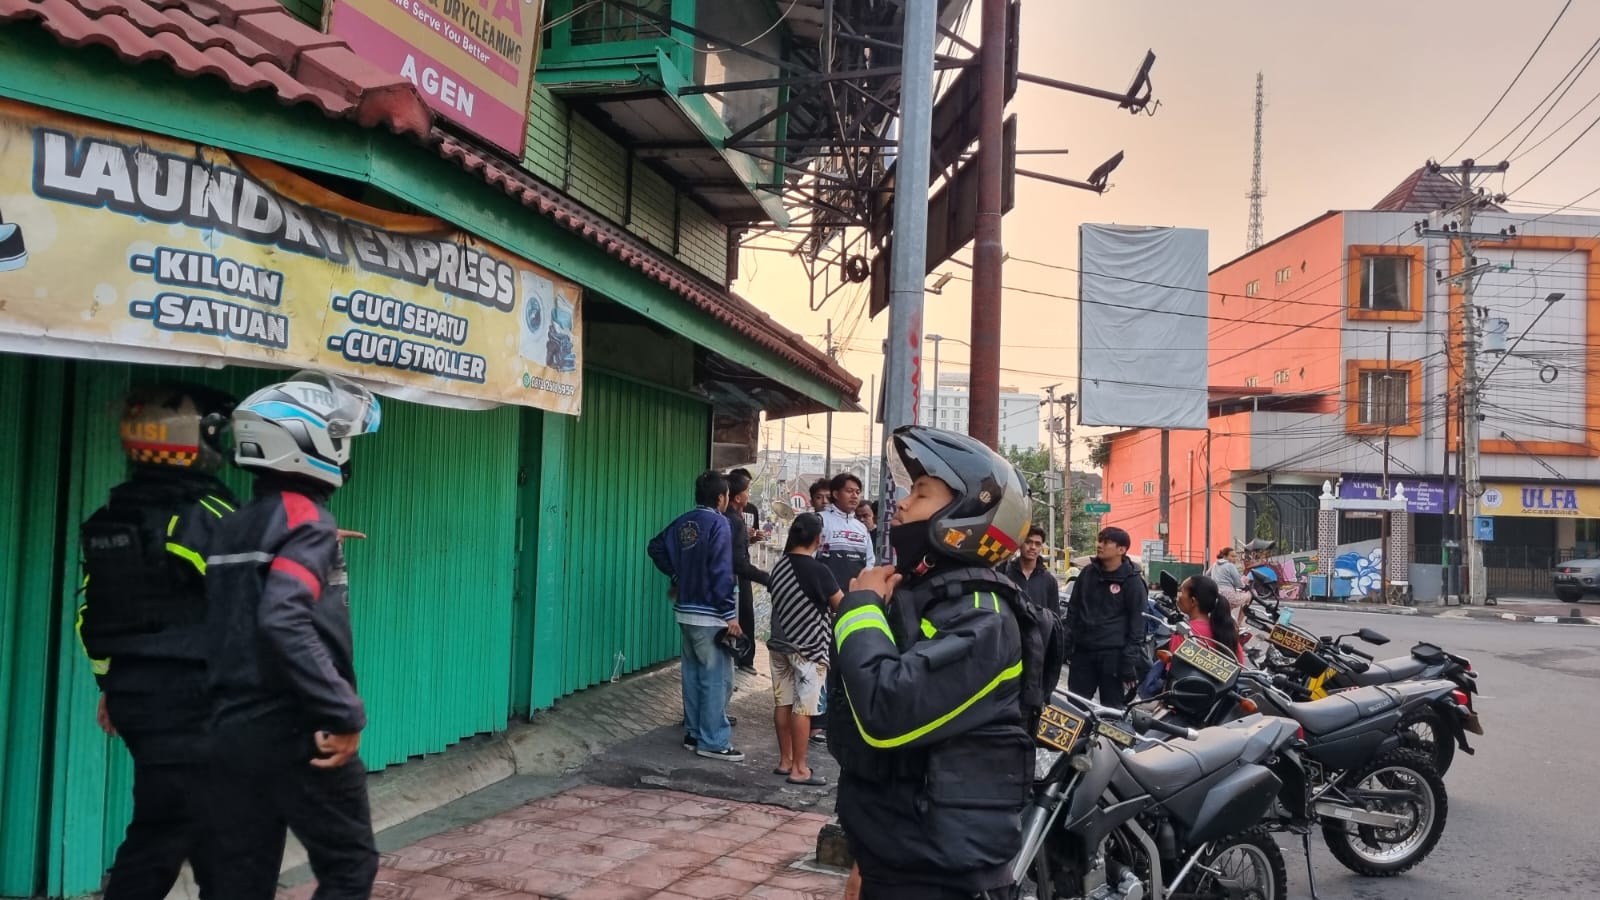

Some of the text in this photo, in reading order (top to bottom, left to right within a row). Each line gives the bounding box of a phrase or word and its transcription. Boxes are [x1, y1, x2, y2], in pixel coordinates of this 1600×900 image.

[413, 2, 440, 31] Serve
[444, 22, 461, 44] You
[463, 35, 490, 64] Better
[400, 54, 475, 118] AGEN
[42, 131, 514, 305] LAUNDRY EXPRESS
[402, 303, 467, 342] SEPATU
[398, 342, 485, 380] STROLLER
[1486, 487, 1578, 509] UF ULFA
[1206, 653, 1230, 668] XXIV
